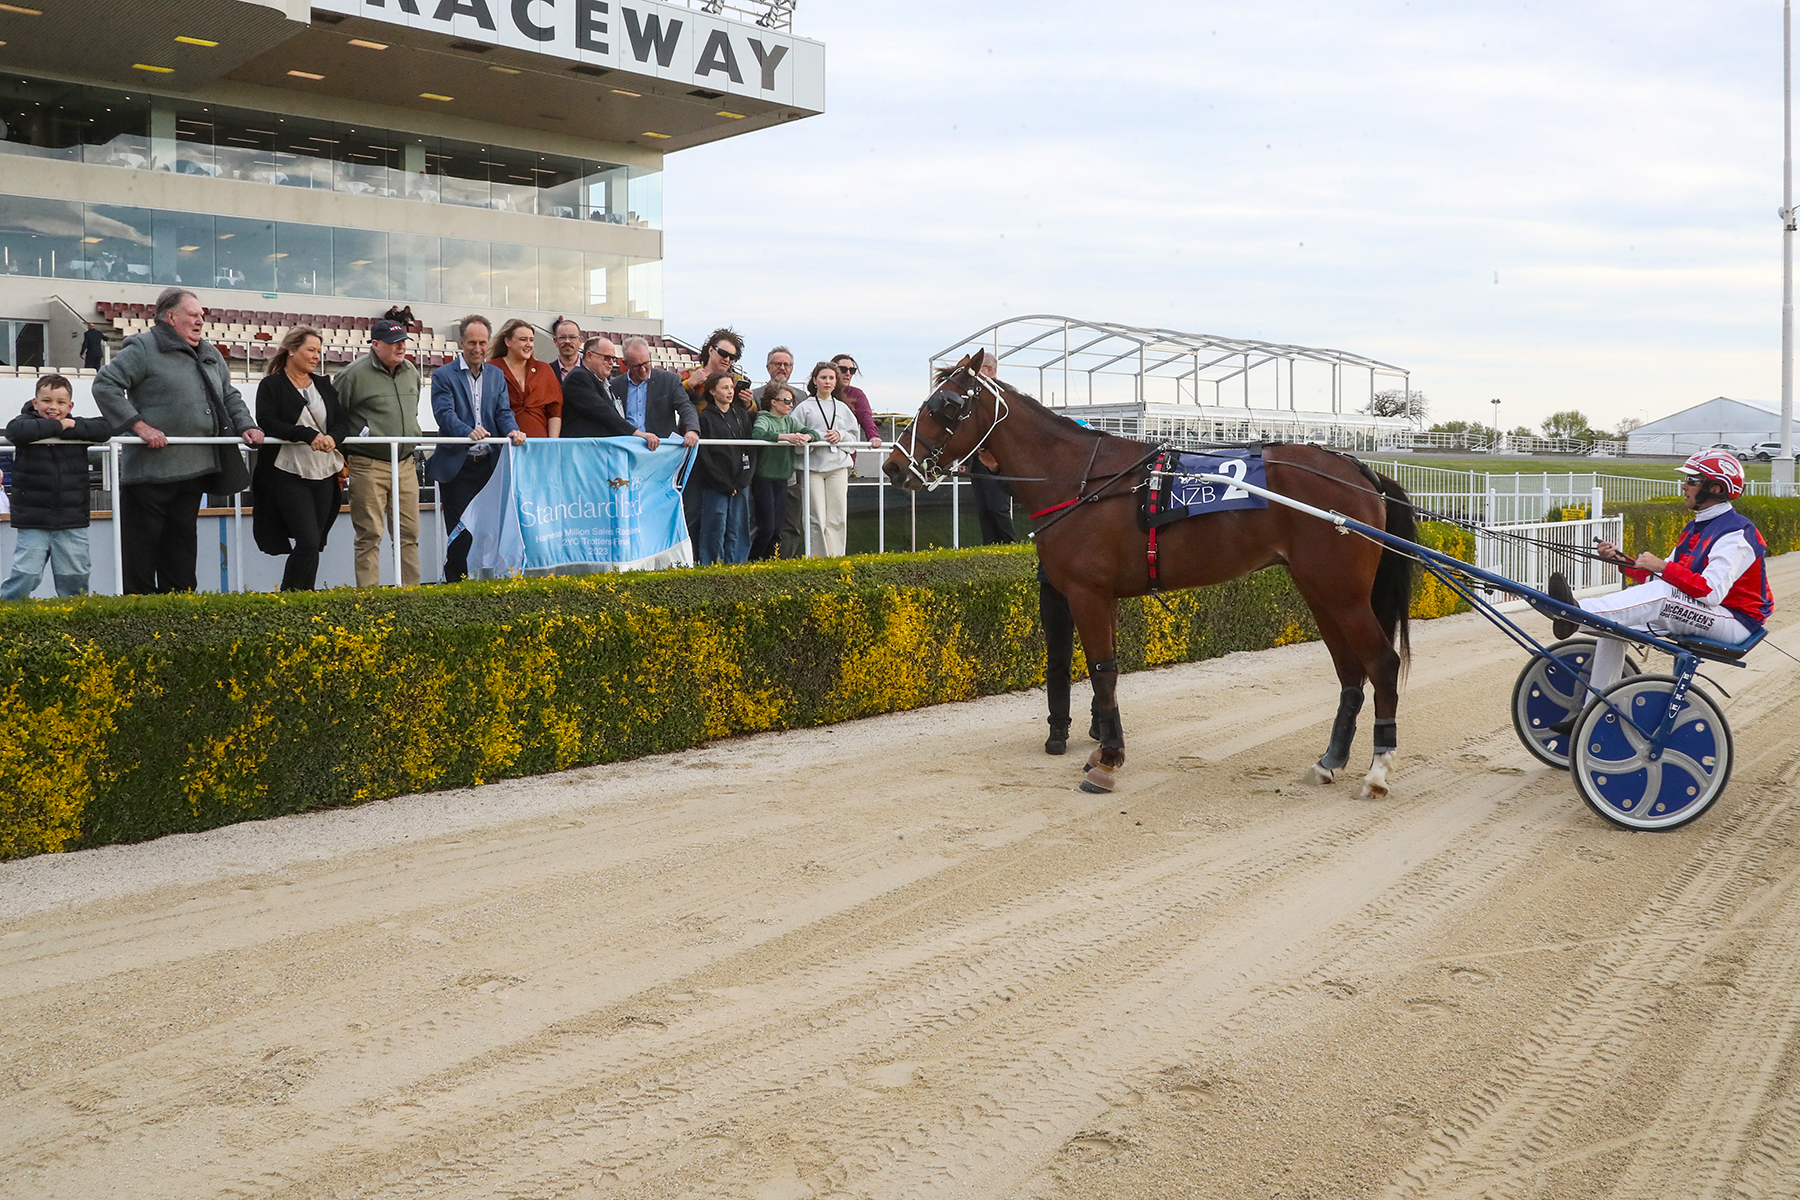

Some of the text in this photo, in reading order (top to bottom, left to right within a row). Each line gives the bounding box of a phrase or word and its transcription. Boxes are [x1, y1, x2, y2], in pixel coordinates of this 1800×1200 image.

[366, 0, 789, 91] ACEWAY
[1218, 459, 1249, 501] 2
[520, 491, 643, 527] Standardbd
[1170, 486, 1216, 509] NZB
[563, 537, 580, 547] 2YO
[582, 537, 612, 547] Trotters
[564, 527, 590, 537] Million
[592, 527, 614, 536] Sales
[588, 547, 609, 556] 2023
